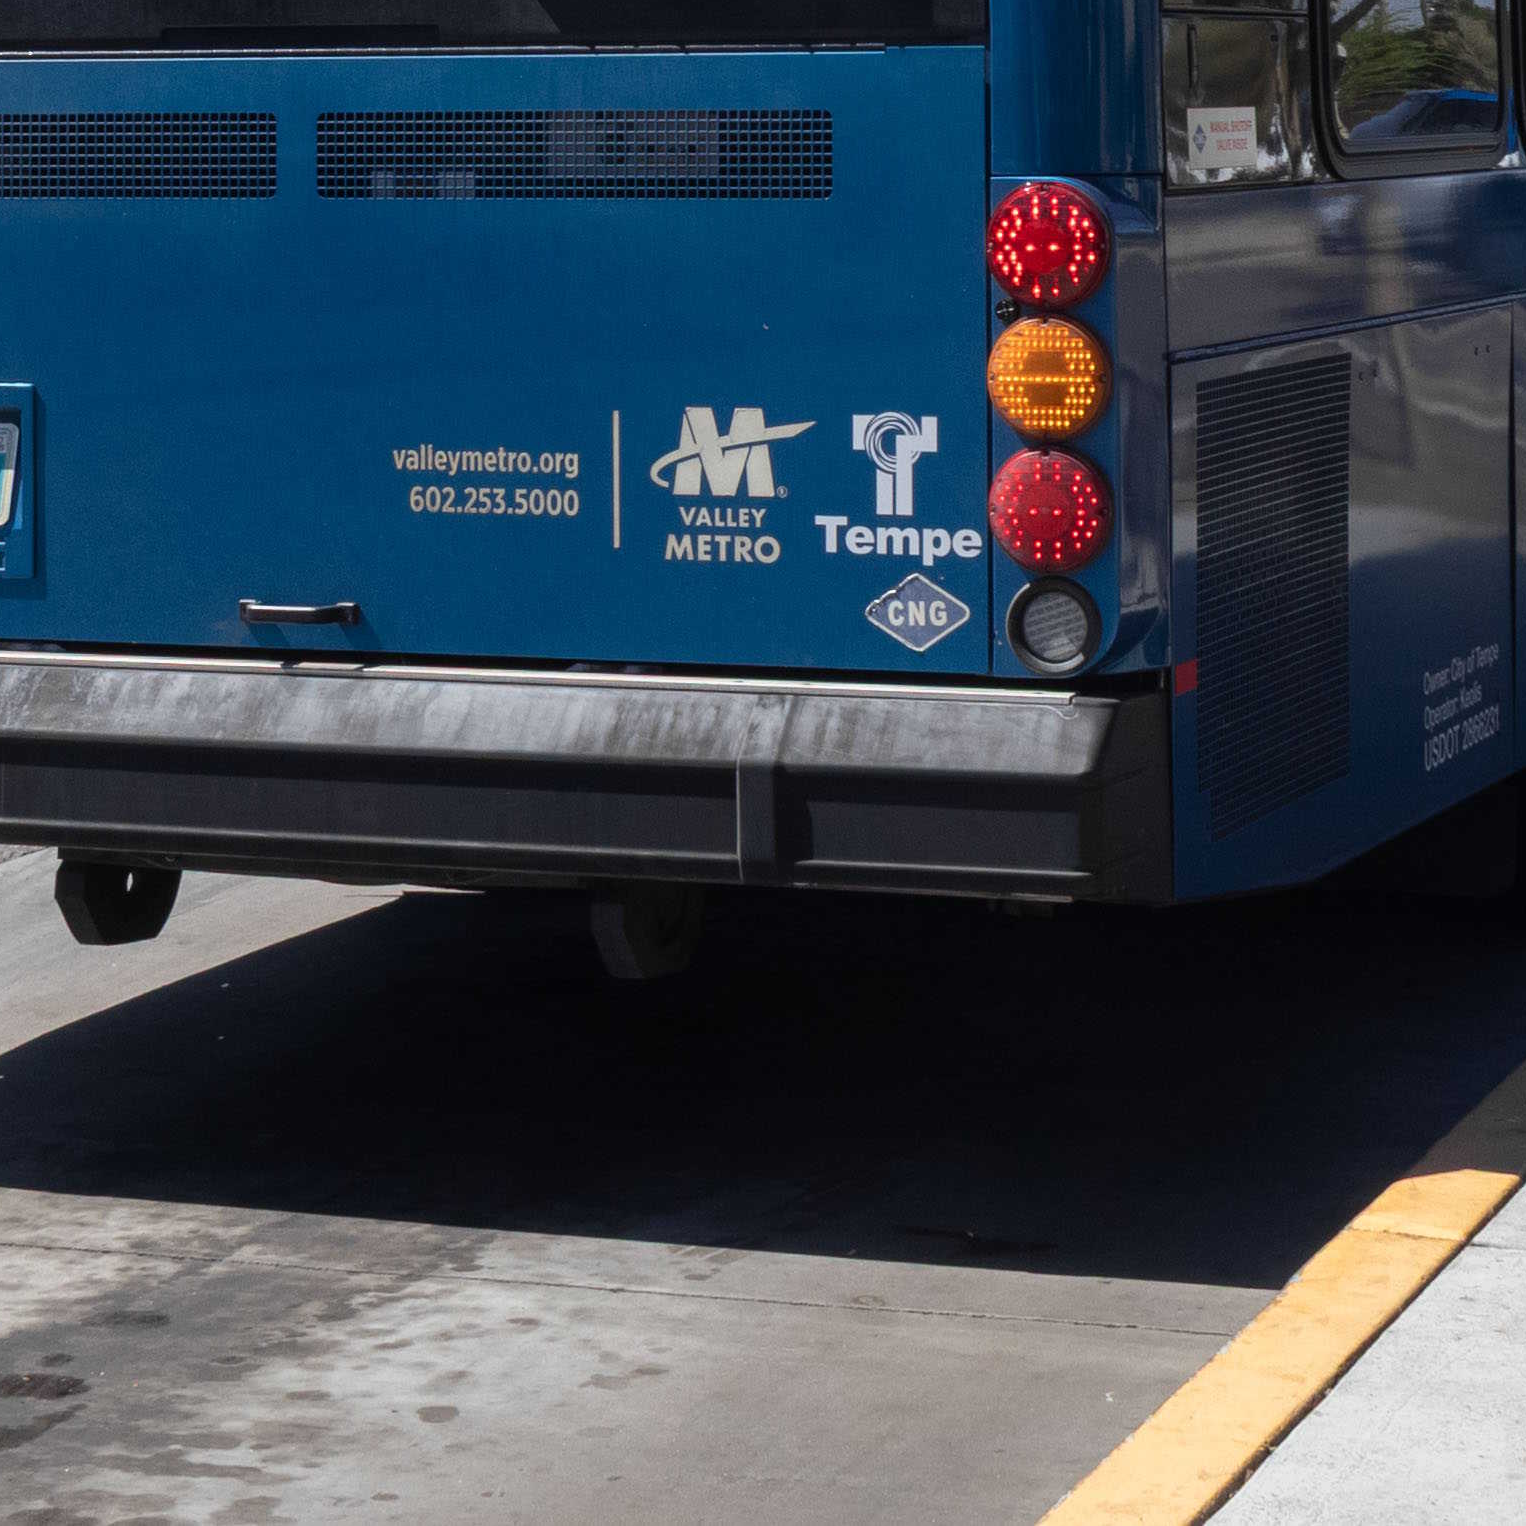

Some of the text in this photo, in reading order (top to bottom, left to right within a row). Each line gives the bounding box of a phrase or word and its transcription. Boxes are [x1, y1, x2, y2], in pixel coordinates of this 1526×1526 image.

[393, 444, 580, 481] valleymetro.org
[409, 489, 580, 517] 602.253.5000
[679, 507, 767, 528] VALLEY
[665, 533, 781, 563] METRO
[815, 515, 983, 566] Tempe
[887, 599, 949, 627] CNG
[1424, 724, 1460, 771] USDOT
